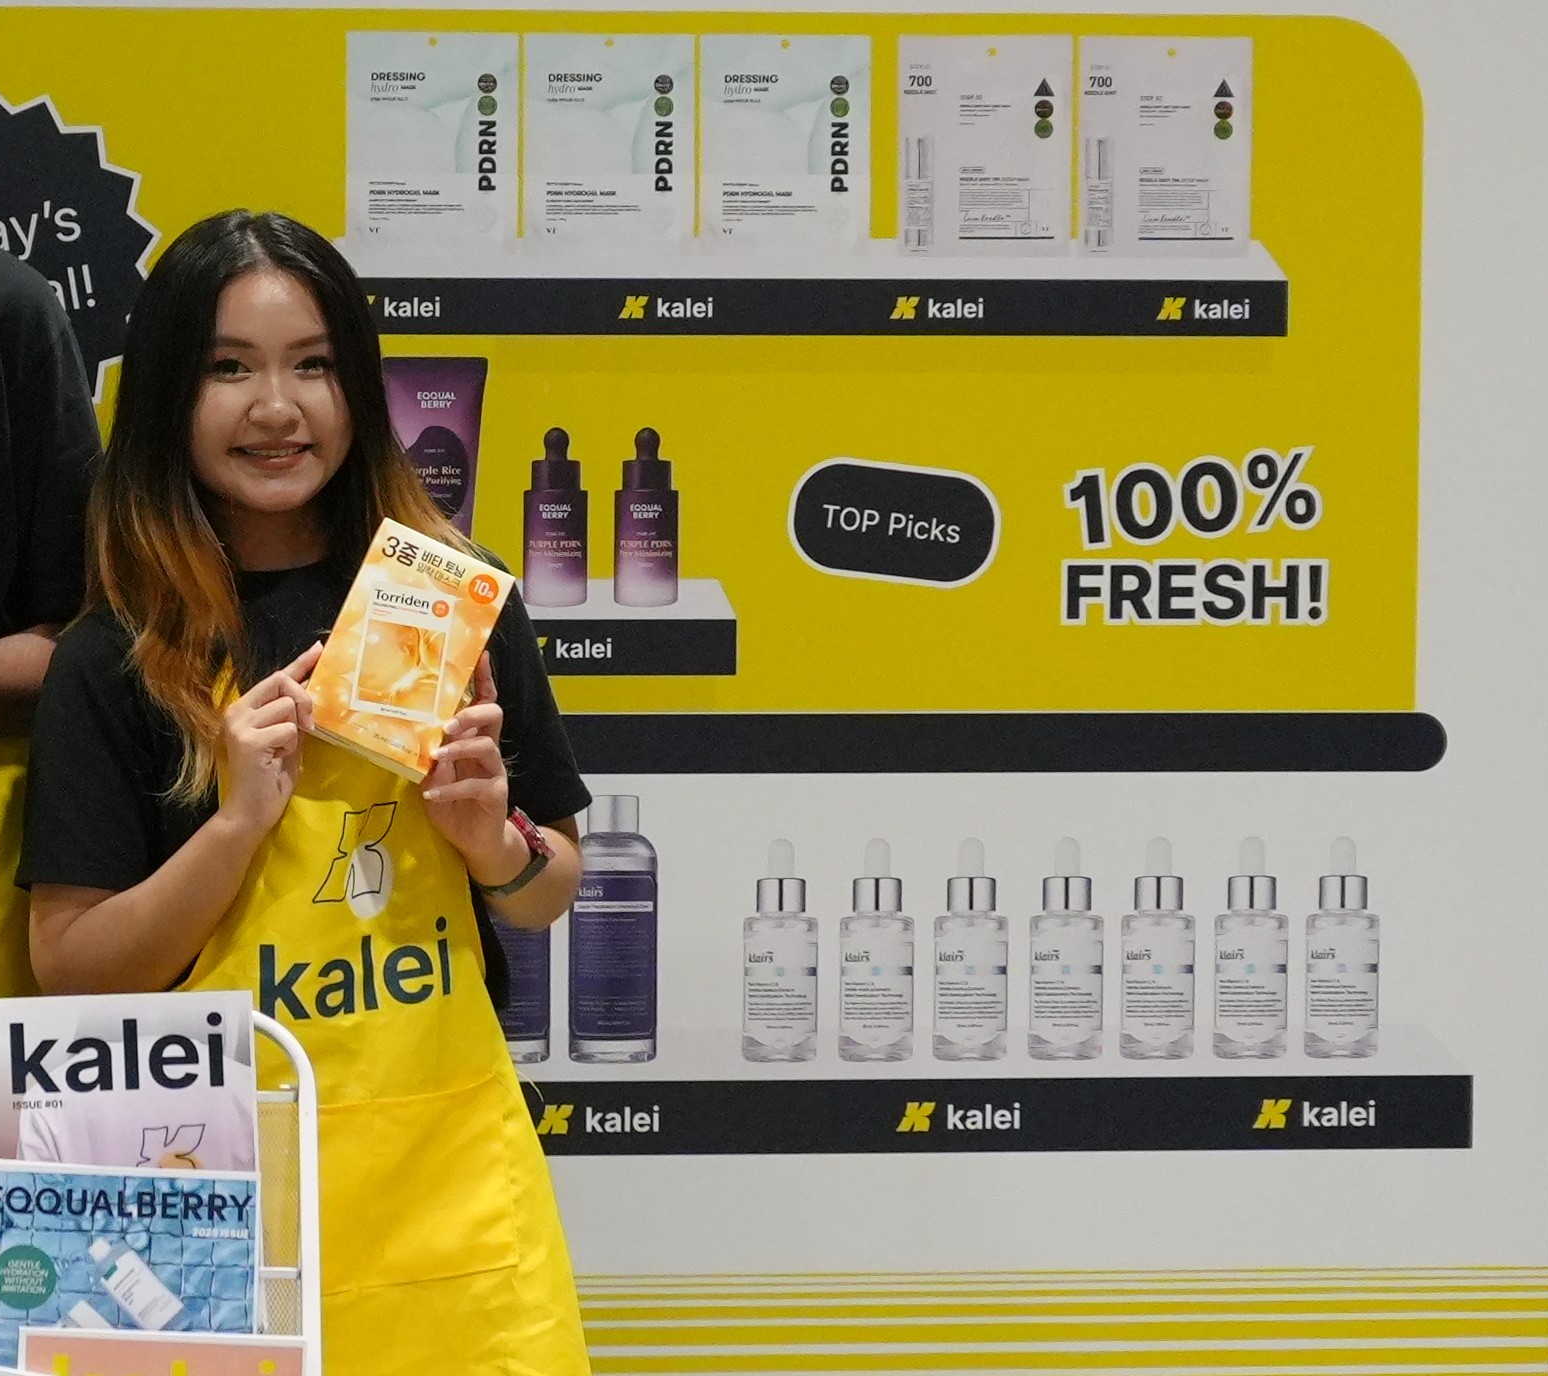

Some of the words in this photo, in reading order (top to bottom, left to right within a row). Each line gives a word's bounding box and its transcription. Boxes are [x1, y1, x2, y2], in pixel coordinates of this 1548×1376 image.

[370, 72, 426, 82] DRESSING
[370, 81, 400, 94] hydro
[548, 73, 603, 83] DRESSING
[724, 74, 779, 84] DRESSING
[908, 75, 933, 87] 700
[1089, 76, 1113, 88] 700
[547, 82, 576, 95] hydro
[724, 84, 752, 96] hydro
[478, 120, 497, 192] PDRN
[654, 121, 673, 192] PDRN
[830, 122, 849, 192] PDRN
[383, 296, 441, 318] kalei
[656, 295, 714, 318] kalei
[926, 297, 985, 319] kalei
[1193, 299, 1251, 320] kalei
[420, 400, 452, 409] BERRY
[411, 466, 440, 477] urple
[441, 465, 462, 475] Rice
[1070, 452, 1320, 545] 100%
[820, 501, 880, 537] TOP
[886, 509, 963, 547] Picks
[381, 536, 420, 568] 3중
[421, 549, 443, 567] 비타
[444, 560, 467, 579] 토닝
[375, 588, 430, 610] Torriden
[1064, 564, 1324, 622] FRESH!
[555, 637, 613, 660] kalei
[257, 916, 453, 1022] kalei
[9, 1011, 226, 1096] kalei
[11, 1099, 43, 1111] ISSUE
[43, 1098, 64, 1110] #01
[945, 1100, 1023, 1131] kalei
[1301, 1097, 1378, 1128] kalei
[584, 1102, 661, 1135] kalei
[220, 1228, 251, 1240] ISSUE
